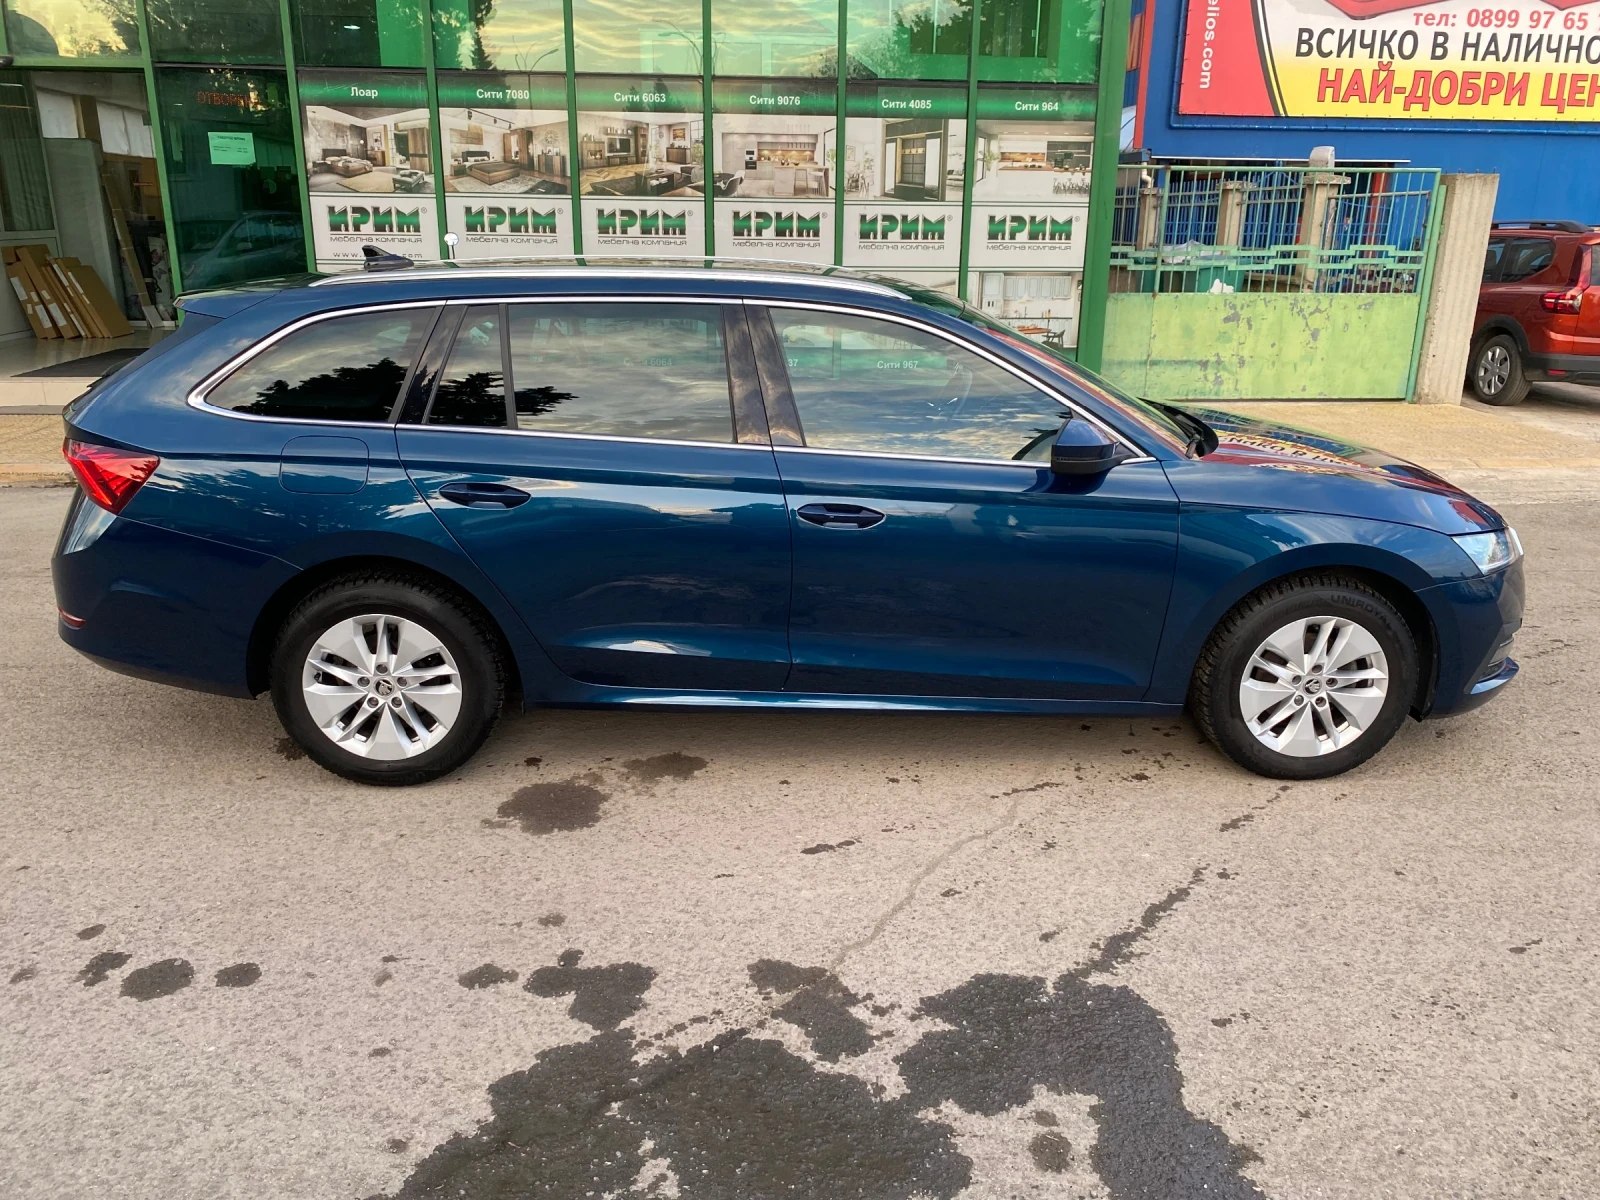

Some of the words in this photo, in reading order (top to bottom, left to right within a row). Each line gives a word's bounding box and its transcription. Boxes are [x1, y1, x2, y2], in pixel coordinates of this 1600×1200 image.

[1413, 12, 1457, 27] тел:
[1466, 8, 1520, 28] 0899
[1529, 10, 1555, 29] 97
[1563, 11, 1589, 30] 65
[1295, 27, 1419, 60] ВСИЧКО
[1430, 31, 1449, 61] В
[1317, 61, 1530, 111] НАЙ-ДОБРИ
[350, 87, 378, 99] Лоар
[476, 89, 503, 99] Сити
[505, 89, 530, 100] 7080
[613, 92, 640, 102] Сити
[642, 93, 666, 103] 6063
[749, 95, 775, 105] Сити
[777, 96, 801, 106] 9076
[881, 99, 906, 109] Сити
[908, 100, 932, 109] 4085
[1014, 101, 1040, 111] Сити
[1041, 102, 1059, 111] 964
[986, 243, 1026, 251] мебелна
